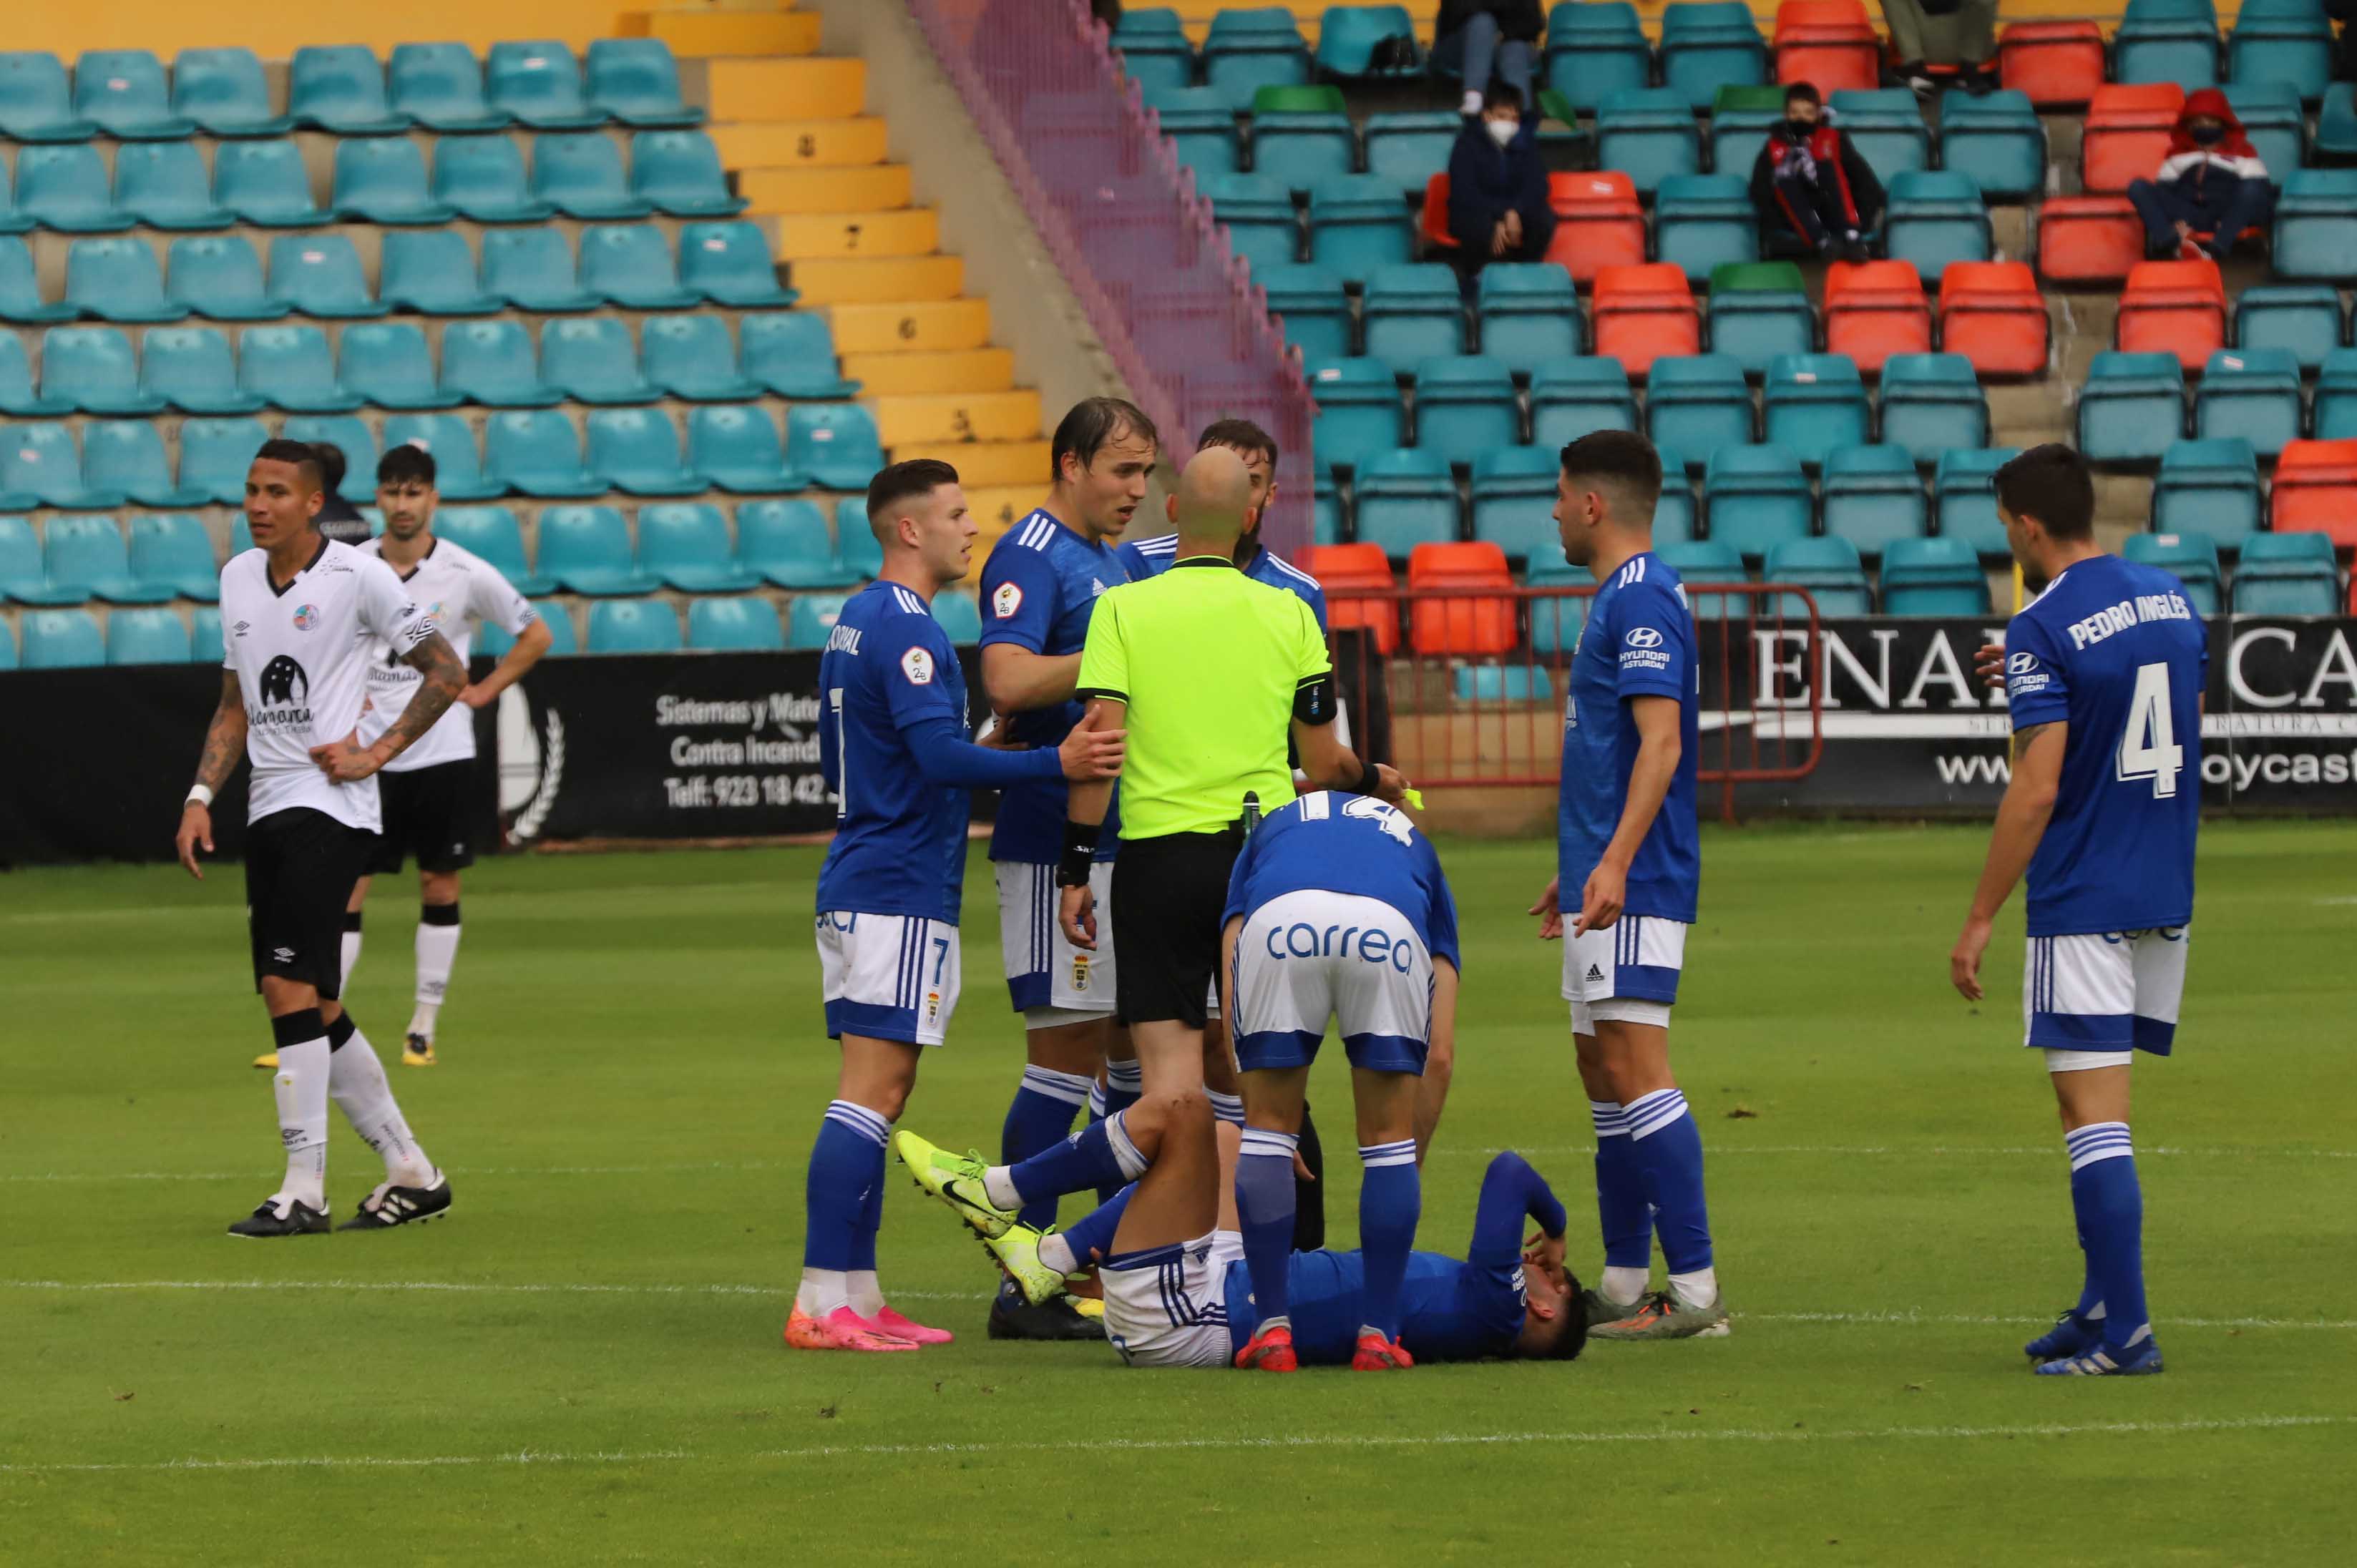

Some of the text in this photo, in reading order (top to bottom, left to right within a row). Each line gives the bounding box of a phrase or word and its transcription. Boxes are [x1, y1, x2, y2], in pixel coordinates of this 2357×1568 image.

[846, 224, 862, 249] 7
[898, 316, 916, 340] 6
[2067, 589, 2192, 650] PEDRO INGLÉS
[1619, 650, 1670, 662] HYUNDAI
[1623, 660, 1665, 670] ASTURDAI
[656, 695, 751, 725] Sistemas
[752, 701, 768, 731] y
[2115, 662, 2183, 799] 4
[670, 735, 745, 766] Contra
[713, 775, 759, 807] 923
[932, 937, 950, 987] 7
